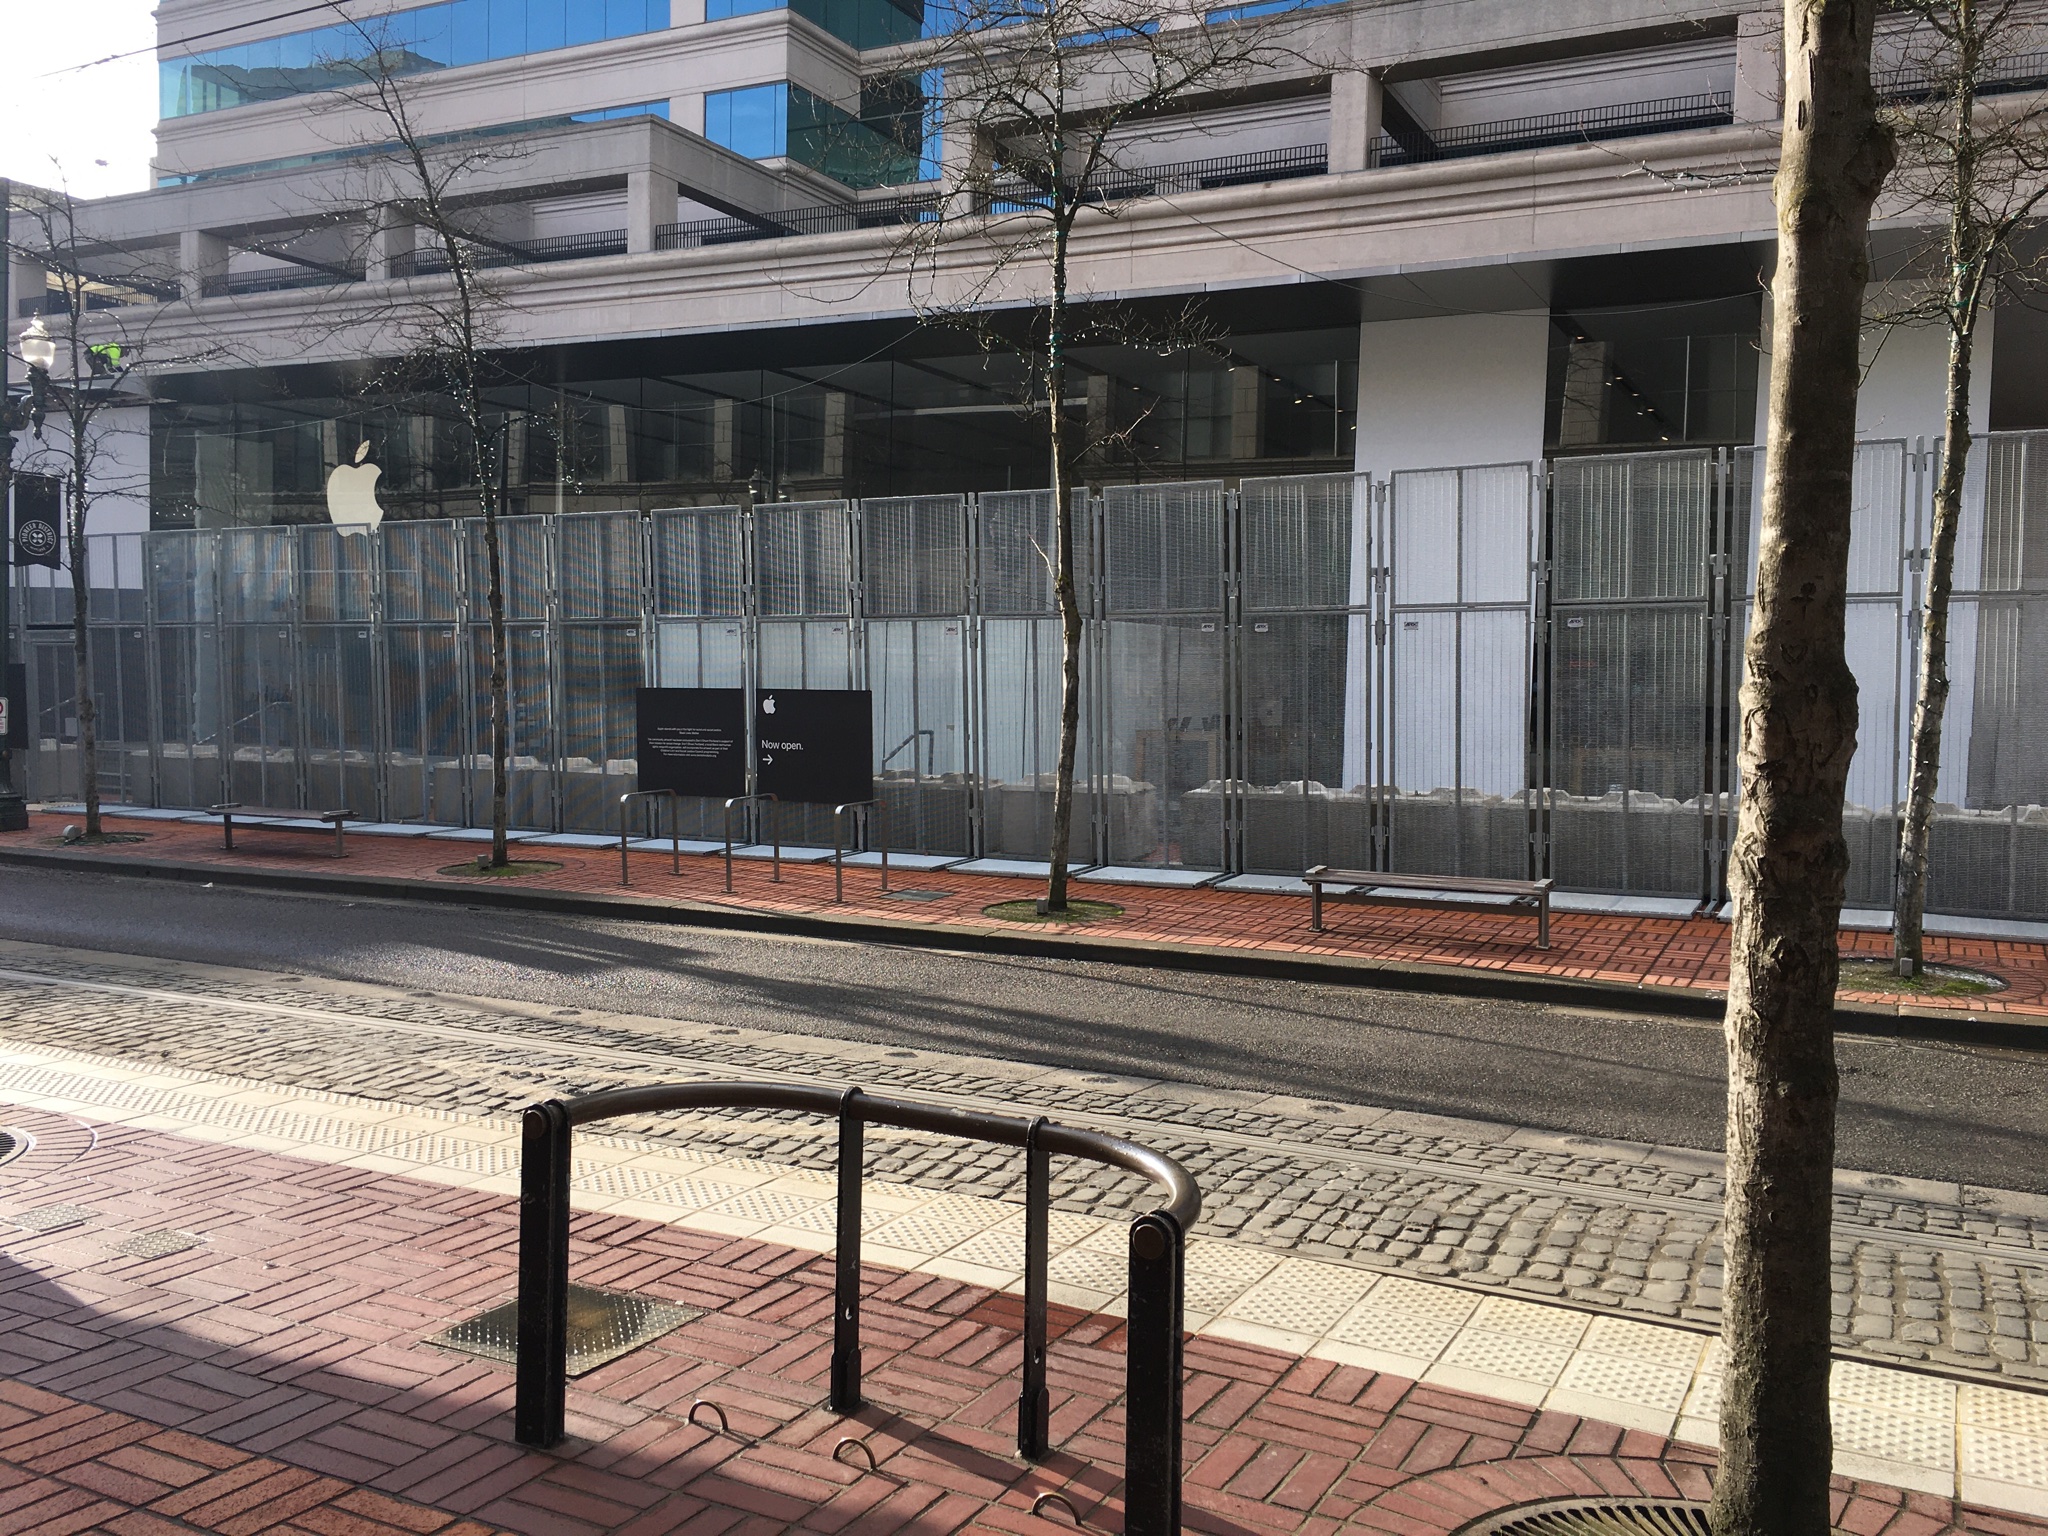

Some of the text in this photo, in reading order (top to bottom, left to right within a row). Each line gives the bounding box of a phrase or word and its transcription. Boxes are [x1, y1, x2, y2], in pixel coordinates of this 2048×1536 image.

[21, 522, 53, 544] PIONEER DISTRICT
[761, 739, 804, 751] Now open.
